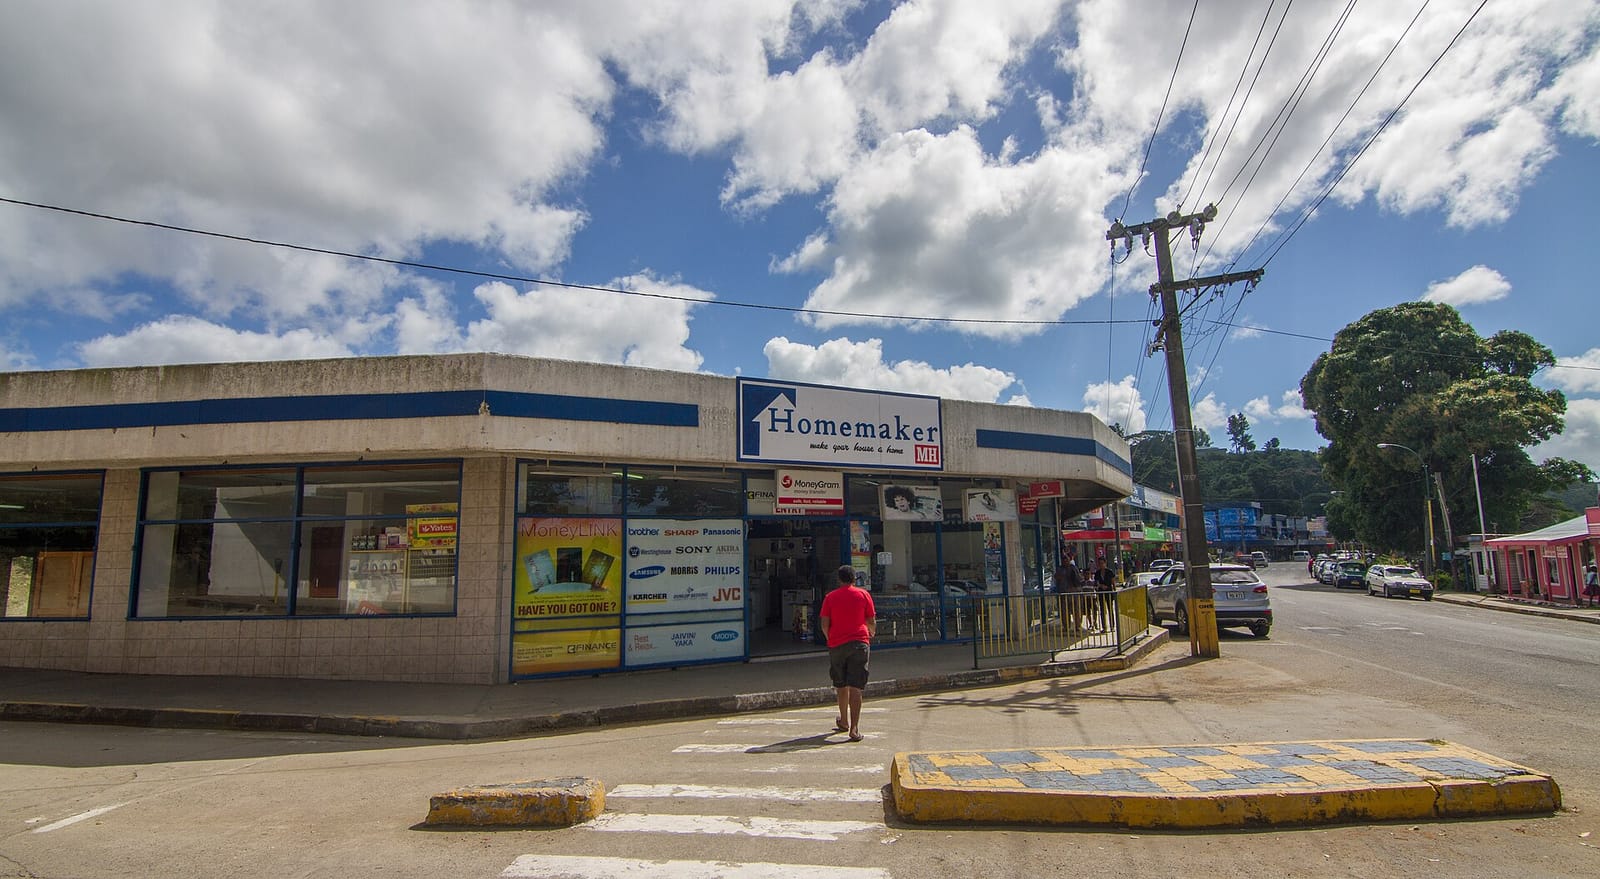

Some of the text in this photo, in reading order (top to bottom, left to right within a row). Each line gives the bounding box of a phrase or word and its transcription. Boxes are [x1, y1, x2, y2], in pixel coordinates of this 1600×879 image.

[767, 407, 938, 442] Homemaker
[810, 441, 828, 450] make
[832, 443, 850, 453] your
[854, 442, 874, 453] house
[886, 445, 904, 454] home
[916, 446, 937, 463] MH
[794, 480, 840, 489] MoneyGram
[521, 523, 617, 540] MoneyLINK
[628, 528, 660, 536] brother
[664, 529, 699, 537] SHARP
[703, 528, 741, 536] Panasonic
[675, 546, 713, 554] SONY
[634, 568, 661, 576] SAMSUNG
[670, 566, 699, 575] MORRIS
[705, 566, 741, 575] PHILIPS
[713, 587, 741, 602] JVC
[518, 605, 545, 616] HAVE
[547, 604, 567, 614] YOU
[569, 603, 588, 614] GOT
[590, 602, 609, 612] ONE
